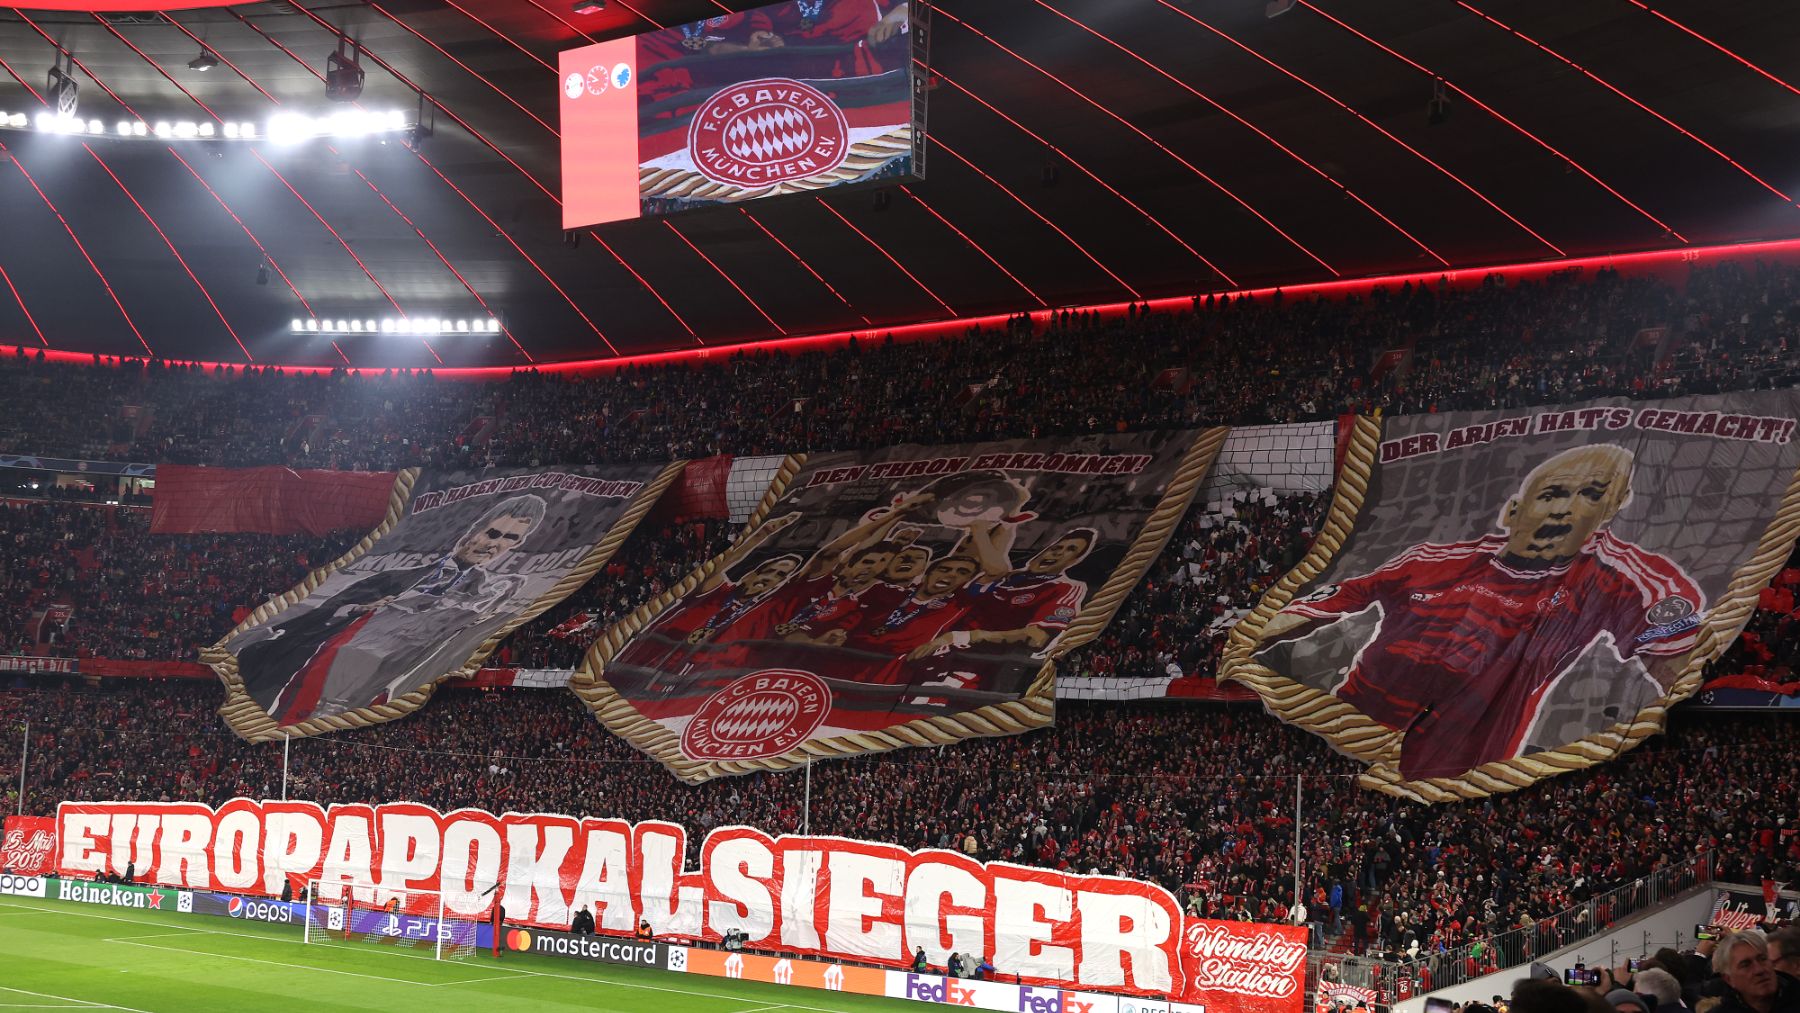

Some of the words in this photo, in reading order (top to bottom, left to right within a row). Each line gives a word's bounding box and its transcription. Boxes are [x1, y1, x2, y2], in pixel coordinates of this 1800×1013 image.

[704, 107, 733, 131] F.C.
[731, 89, 828, 119] BAYERN
[702, 147, 817, 180] MÜNCHEN
[815, 135, 836, 158] E.V.
[1379, 433, 1440, 463] DER
[1444, 416, 1532, 450] ARJEN
[1535, 407, 1634, 434] HAT'S
[1637, 408, 1797, 444] GEMACHT!
[807, 465, 867, 488] DEN
[868, 457, 970, 480] THRON
[971, 452, 1152, 475] ERKLOMMEN!
[755, 678, 818, 714] BAYERN
[691, 718, 764, 756] MÜNCHEN
[5, 851, 44, 870] 2013
[59, 879, 145, 909] Heineken
[246, 901, 293, 923] pepsi
[406, 919, 453, 940] PS5
[1188, 925, 1302, 970] Wembley
[536, 933, 657, 965] mastercard
[906, 972, 976, 1007] FedEx
[1199, 958, 1294, 996] Stadion
[1019, 986, 1094, 1013] FedEx
